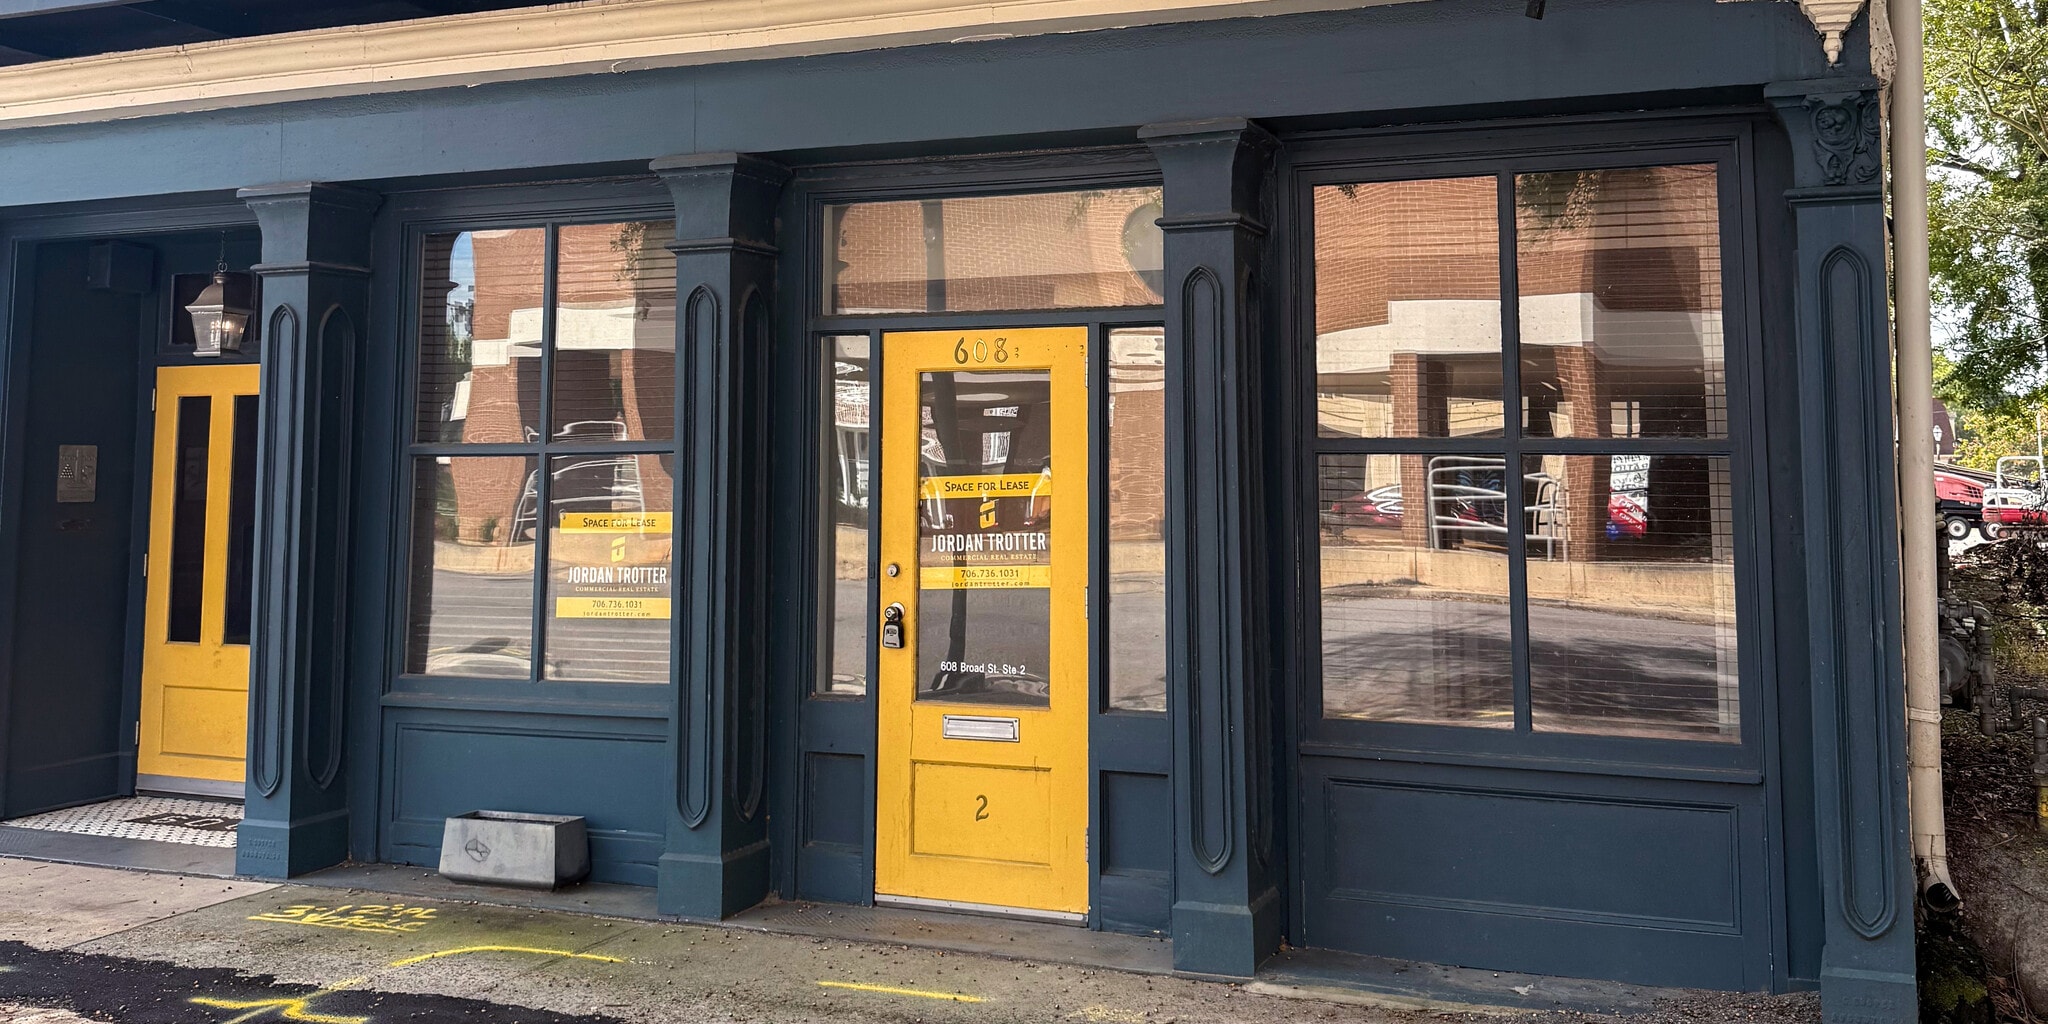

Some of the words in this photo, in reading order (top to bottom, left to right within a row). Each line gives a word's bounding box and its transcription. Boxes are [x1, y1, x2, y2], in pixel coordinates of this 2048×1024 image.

[954, 337, 1009, 364] 608
[931, 534, 983, 552] JORDAN
[986, 532, 1046, 551] TROTTER
[567, 566, 613, 584] JORDAN
[616, 566, 667, 584] TROTTER
[960, 569, 1019, 578] 706.736.1031
[592, 600, 642, 609] 706.736.1031
[940, 661, 958, 671] 608
[960, 661, 985, 673] Broad
[987, 663, 999, 674] St.
[1002, 663, 1017, 675] Ste
[1019, 664, 1026, 675] 2
[975, 794, 990, 822] 2
